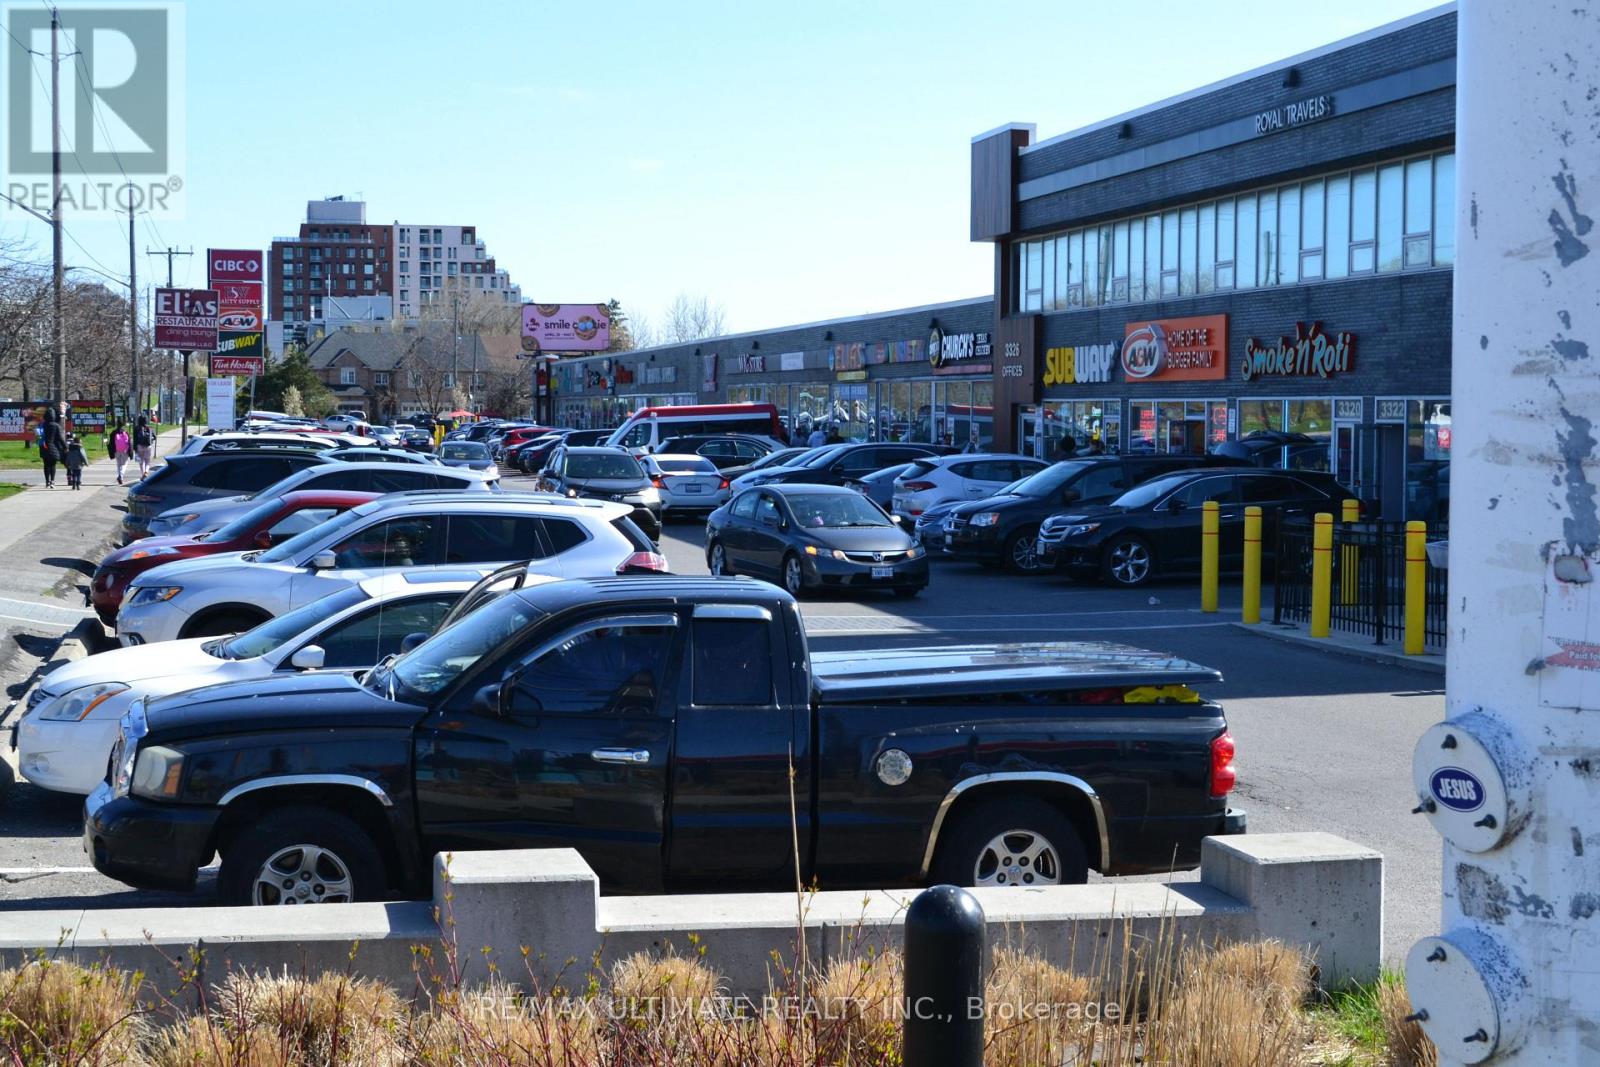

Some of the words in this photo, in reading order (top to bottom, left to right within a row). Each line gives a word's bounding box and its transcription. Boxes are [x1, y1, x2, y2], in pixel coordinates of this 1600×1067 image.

[1255, 109, 1282, 133] ROYAL
[1286, 96, 1325, 124] TRAVELS
[214, 259, 245, 271] CIBC
[156, 316, 217, 328] RESTAURANT
[223, 316, 255, 327] A&W
[544, 319, 571, 330] smile
[214, 333, 261, 353] SUBWAY
[1167, 330, 1185, 347] HOME
[1185, 329, 1195, 346] OF
[1195, 328, 1208, 345] THE
[942, 333, 975, 360] CHURCH'S
[1004, 342, 1021, 357] 3326
[213, 358, 229, 369] Tim
[1043, 341, 1116, 387] SUBWAY
[1127, 344, 1158, 369] A&W
[1167, 351, 1191, 369] BURGER
[1191, 350, 1214, 368] FAMILY
[1241, 336, 1296, 381] Smoke
[1312, 332, 1351, 378] Roti
[1001, 365, 1024, 378] OFFICES
[1338, 401, 1361, 417] 3320
[1380, 401, 1405, 417] 3322
[1439, 778, 1477, 801] JESUS
